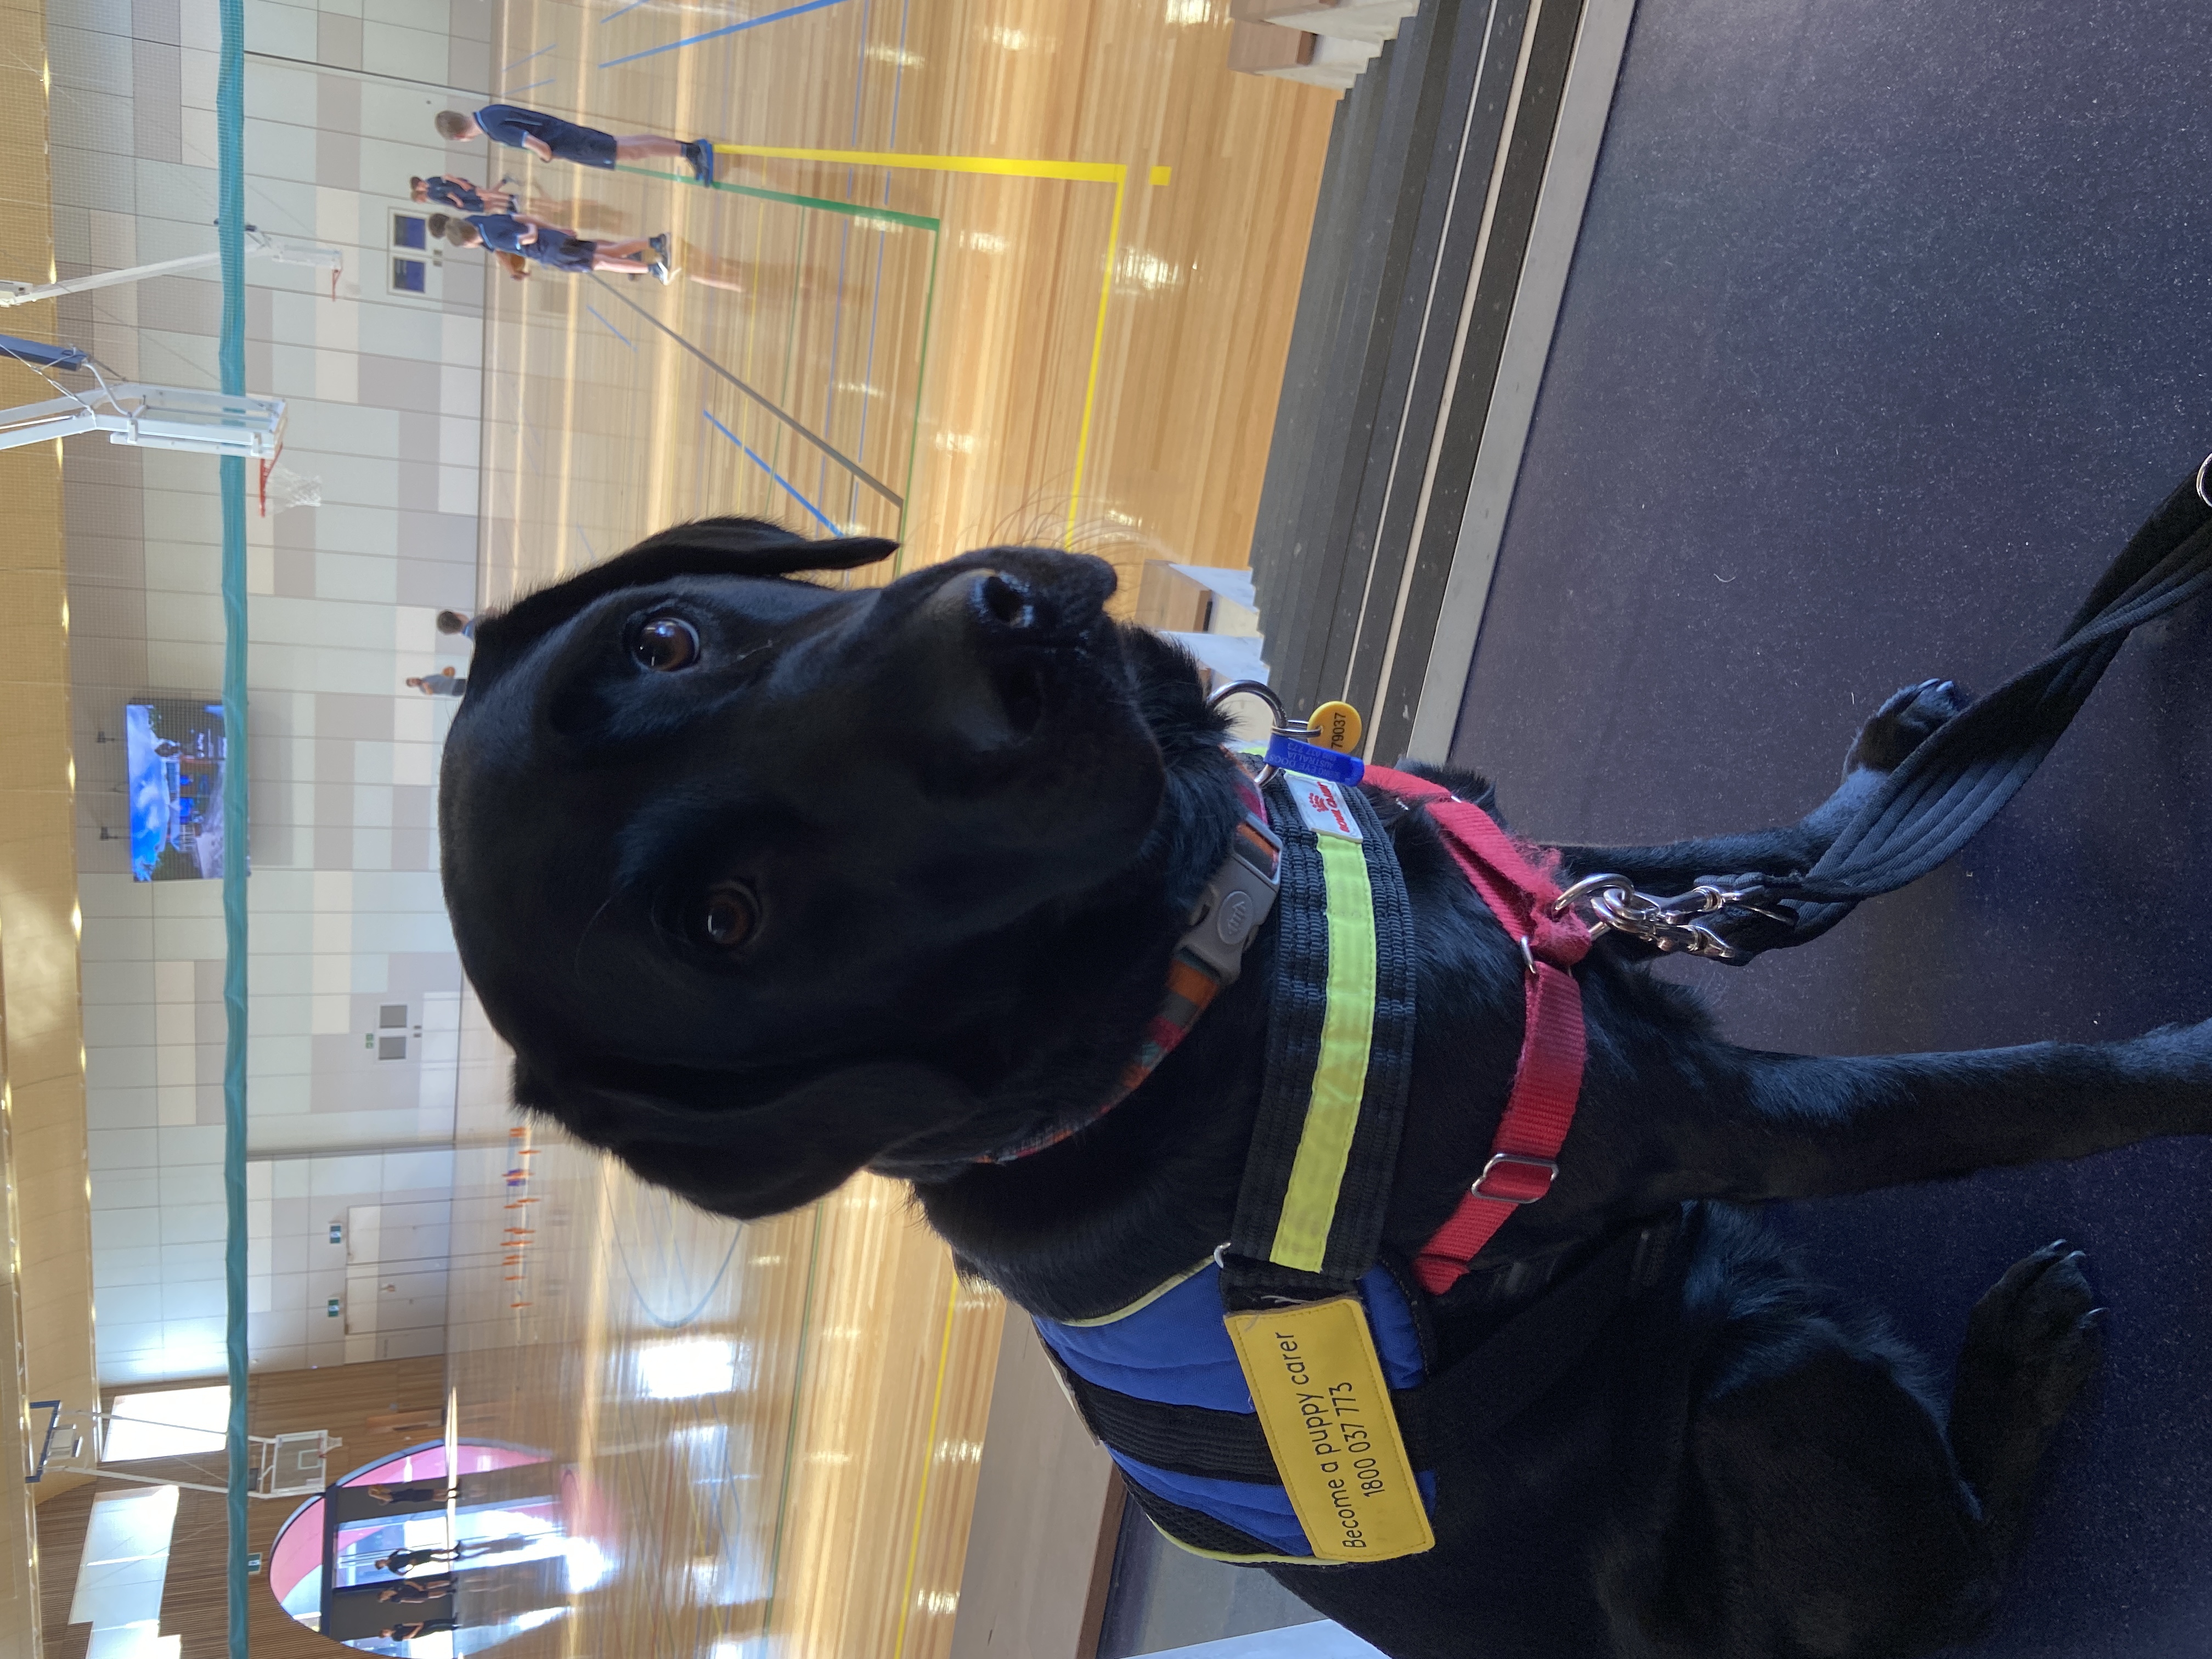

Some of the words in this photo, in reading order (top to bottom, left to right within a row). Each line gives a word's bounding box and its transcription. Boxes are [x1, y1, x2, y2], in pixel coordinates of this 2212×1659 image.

[1331, 712, 1346, 748] 79037
[1269, 754, 1296, 768] DOGS
[1288, 751, 1334, 770] AUSTRALIA
[1300, 764, 1317, 775] EYE
[1274, 1332, 1309, 1385] carer
[1328, 1382, 1359, 1417] 773
[1296, 1393, 1340, 1455] puppy
[1341, 1423, 1370, 1452] 037
[1320, 1461, 1339, 1472] a
[1353, 1458, 1385, 1496] 1800
[1327, 1479, 1367, 1547] Become
